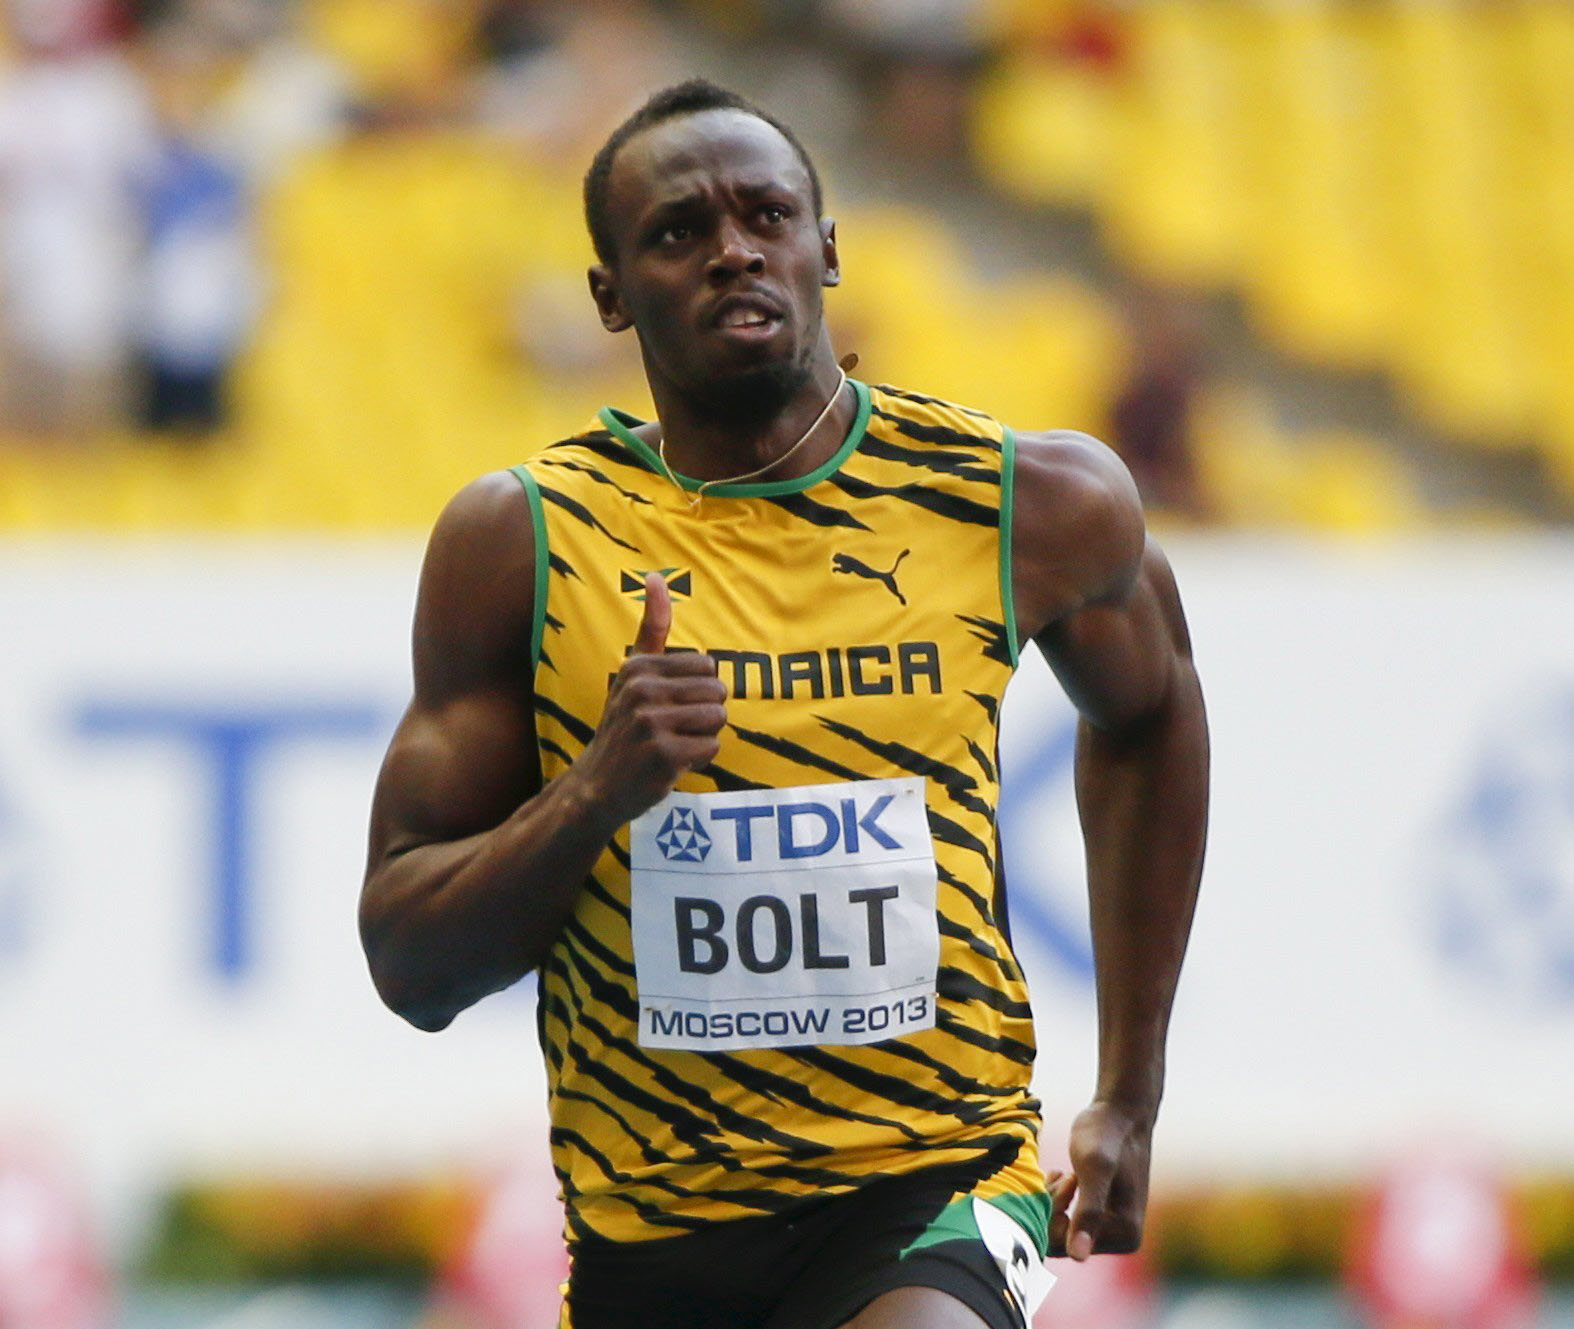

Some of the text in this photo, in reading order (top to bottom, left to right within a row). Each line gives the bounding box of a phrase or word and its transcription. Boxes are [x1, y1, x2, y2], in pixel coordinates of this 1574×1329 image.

[607, 642, 942, 700] MAICA
[710, 794, 905, 862] TDK
[674, 885, 900, 975] BOLT
[651, 996, 928, 1039] MOSCOW 2013
